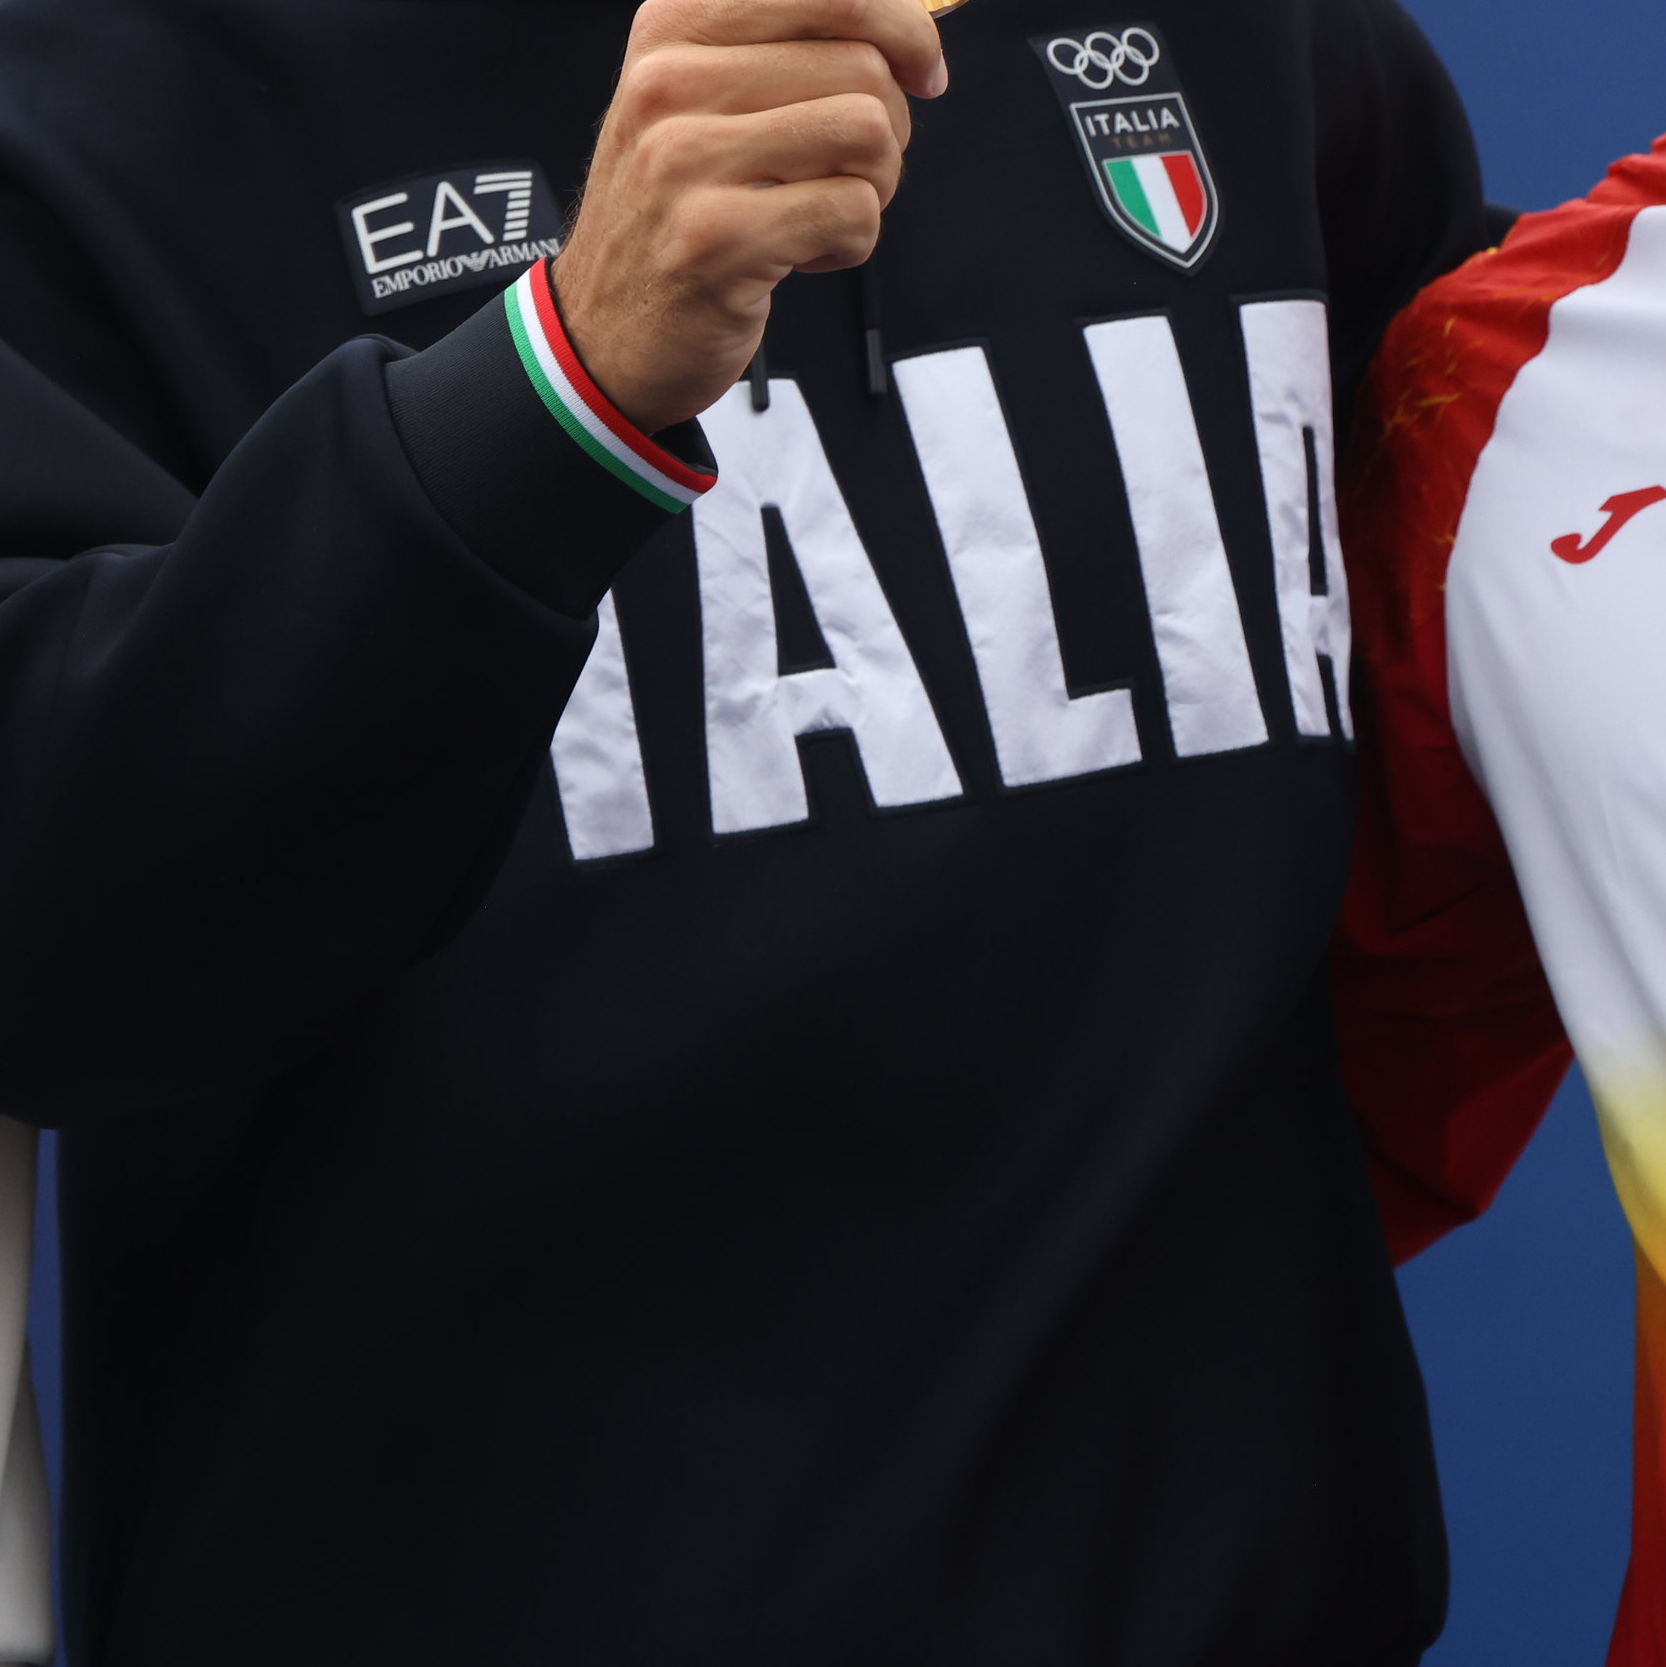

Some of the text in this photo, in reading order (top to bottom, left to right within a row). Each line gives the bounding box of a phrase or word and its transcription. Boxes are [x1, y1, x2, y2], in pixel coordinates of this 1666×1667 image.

[1085, 107, 1180, 137] ITALIA
[351, 171, 533, 275] EA7
[371, 237, 560, 299] EMPORIO ARMANI
